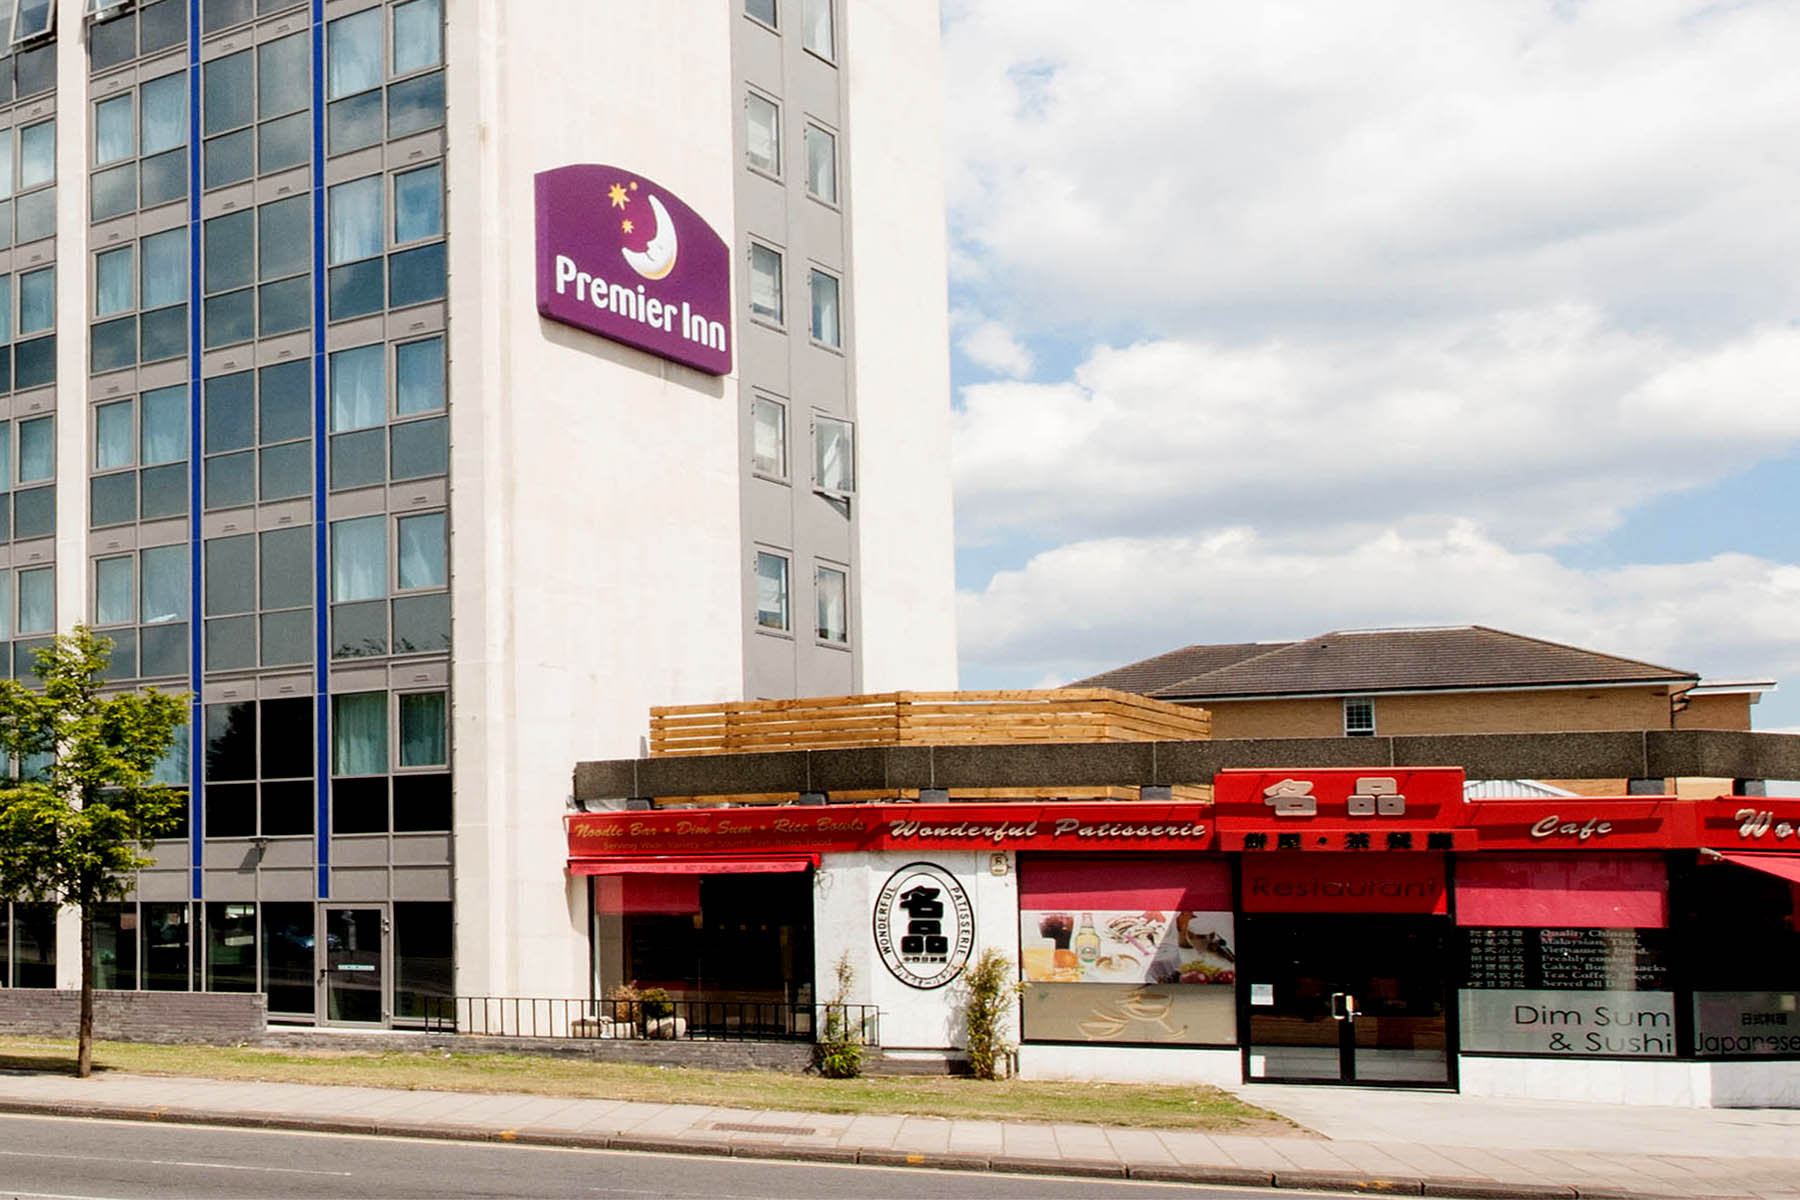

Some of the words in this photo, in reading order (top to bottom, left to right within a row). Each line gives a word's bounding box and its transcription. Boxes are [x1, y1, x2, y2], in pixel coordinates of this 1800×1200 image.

[554, 254, 678, 333] Premier
[682, 301, 726, 352] Inn
[574, 822, 624, 838] Noodle
[630, 822, 657, 837] Bar
[676, 820, 710, 836] Dim
[717, 820, 753, 835] Sum
[773, 818, 809, 833] Rice
[815, 816, 865, 832] Bowls
[889, 819, 1037, 842] Wonderful
[1053, 817, 1206, 837] Patisserie
[1530, 814, 1613, 840] Cafe
[1735, 808, 1800, 838] Wo
[1251, 877, 1442, 897] Restaurant
[877, 887, 897, 956] WONDERFUL
[950, 886, 971, 955] PATISSERIE
[1540, 929, 1585, 939] Quality
[1541, 954, 1586, 964] Freshly
[1542, 979, 1584, 987] Served
[1515, 1005, 1582, 1025] Dim
[1594, 1006, 1670, 1027] Sum
[1549, 1032, 1573, 1051] &
[1585, 1031, 1672, 1053] Sushi
